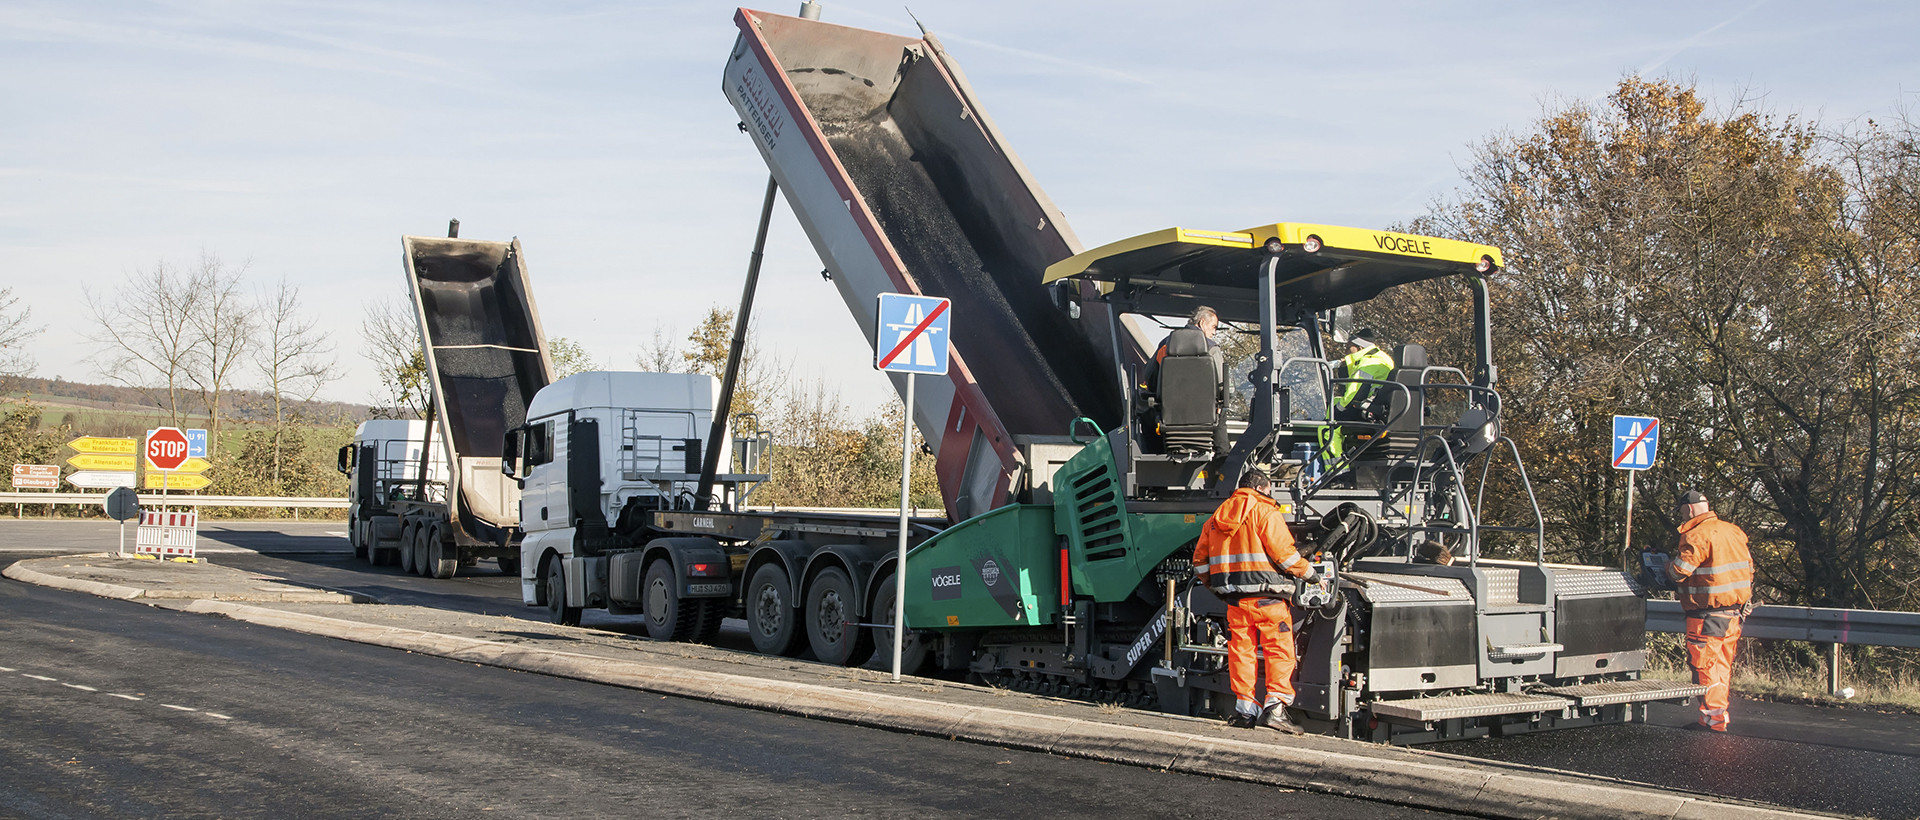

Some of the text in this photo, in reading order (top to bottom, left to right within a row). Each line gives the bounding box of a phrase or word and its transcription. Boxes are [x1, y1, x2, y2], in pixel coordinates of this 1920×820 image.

[737, 85, 776, 150] PATTENSEN
[1373, 234, 1432, 255] VÖGELE
[150, 440, 186, 458] STOP
[23, 478, 50, 486] Glauberg
[693, 517, 714, 528] CARNEHL
[932, 574, 961, 587] VÖGELE
[1126, 632, 1153, 667] SUPER
